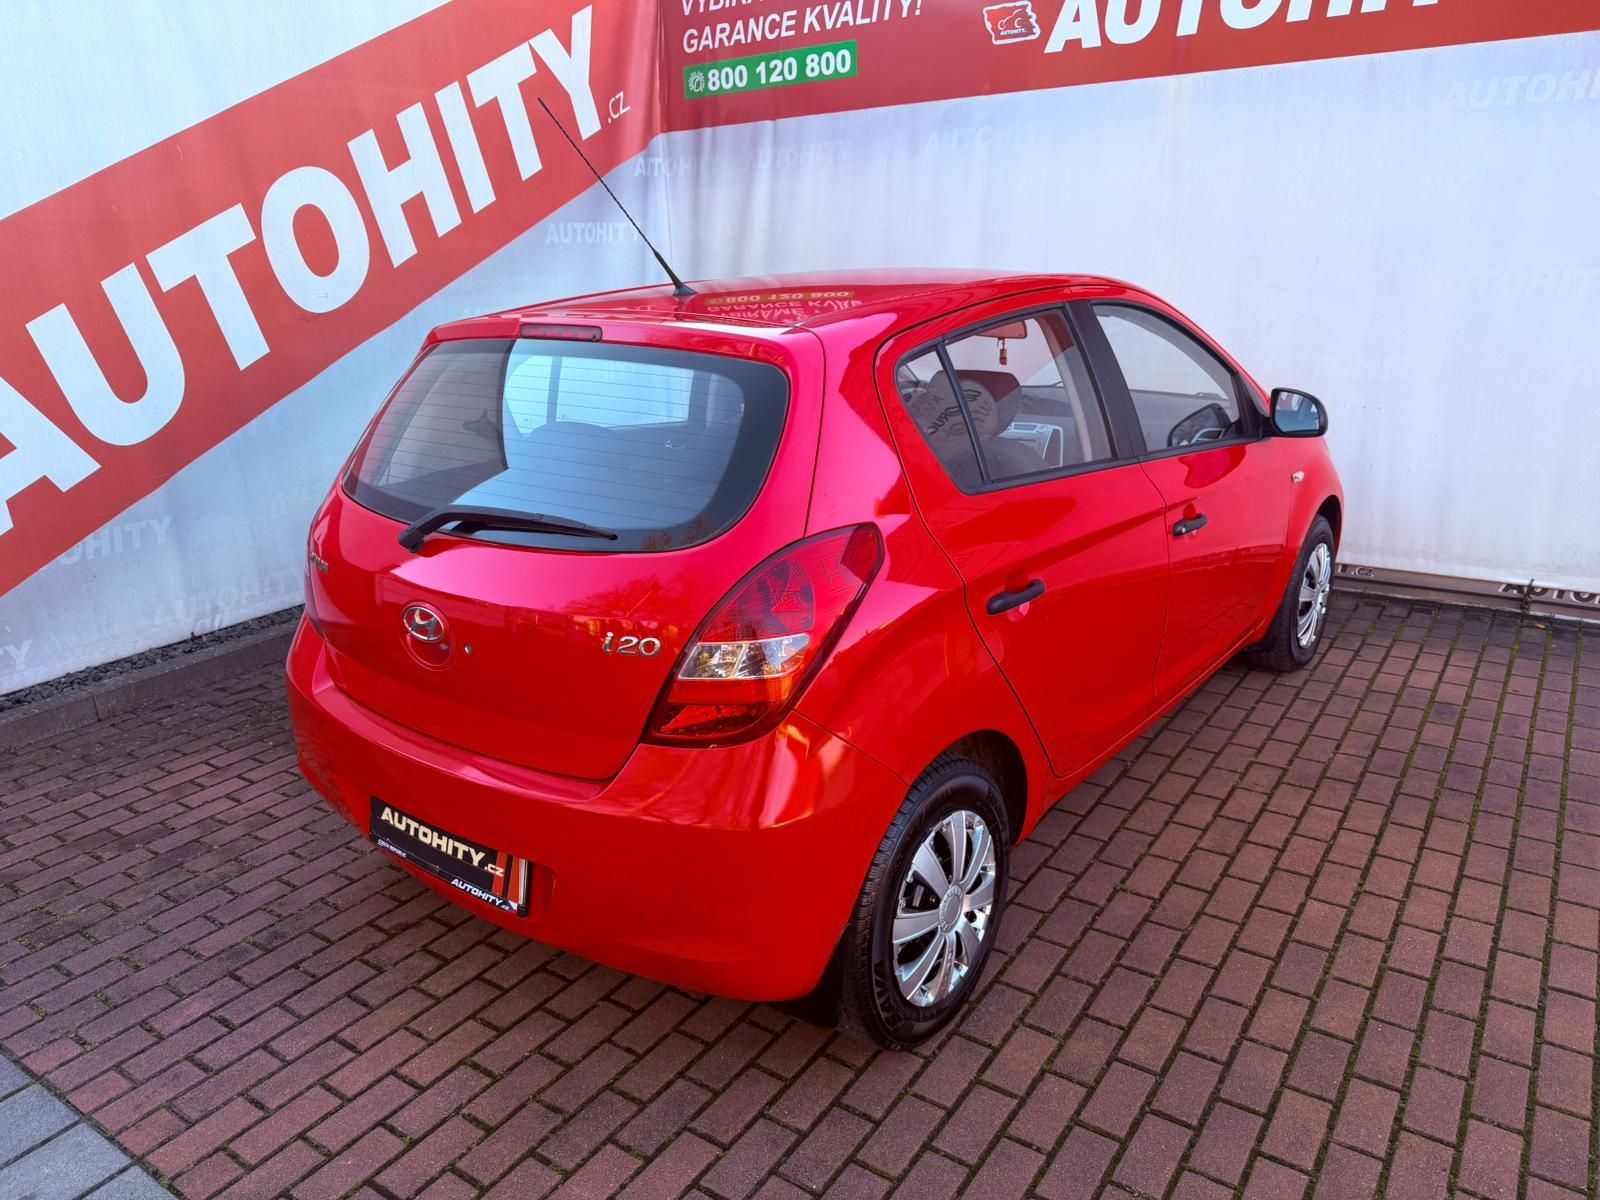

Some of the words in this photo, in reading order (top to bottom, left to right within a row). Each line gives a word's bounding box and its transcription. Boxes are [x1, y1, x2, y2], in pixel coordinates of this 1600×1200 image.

[683, 10, 798, 53] GARANCE
[707, 65, 748, 92] 800
[755, 57, 798, 85] 120
[805, 49, 852, 78] 800
[602, 631, 662, 657] i20
